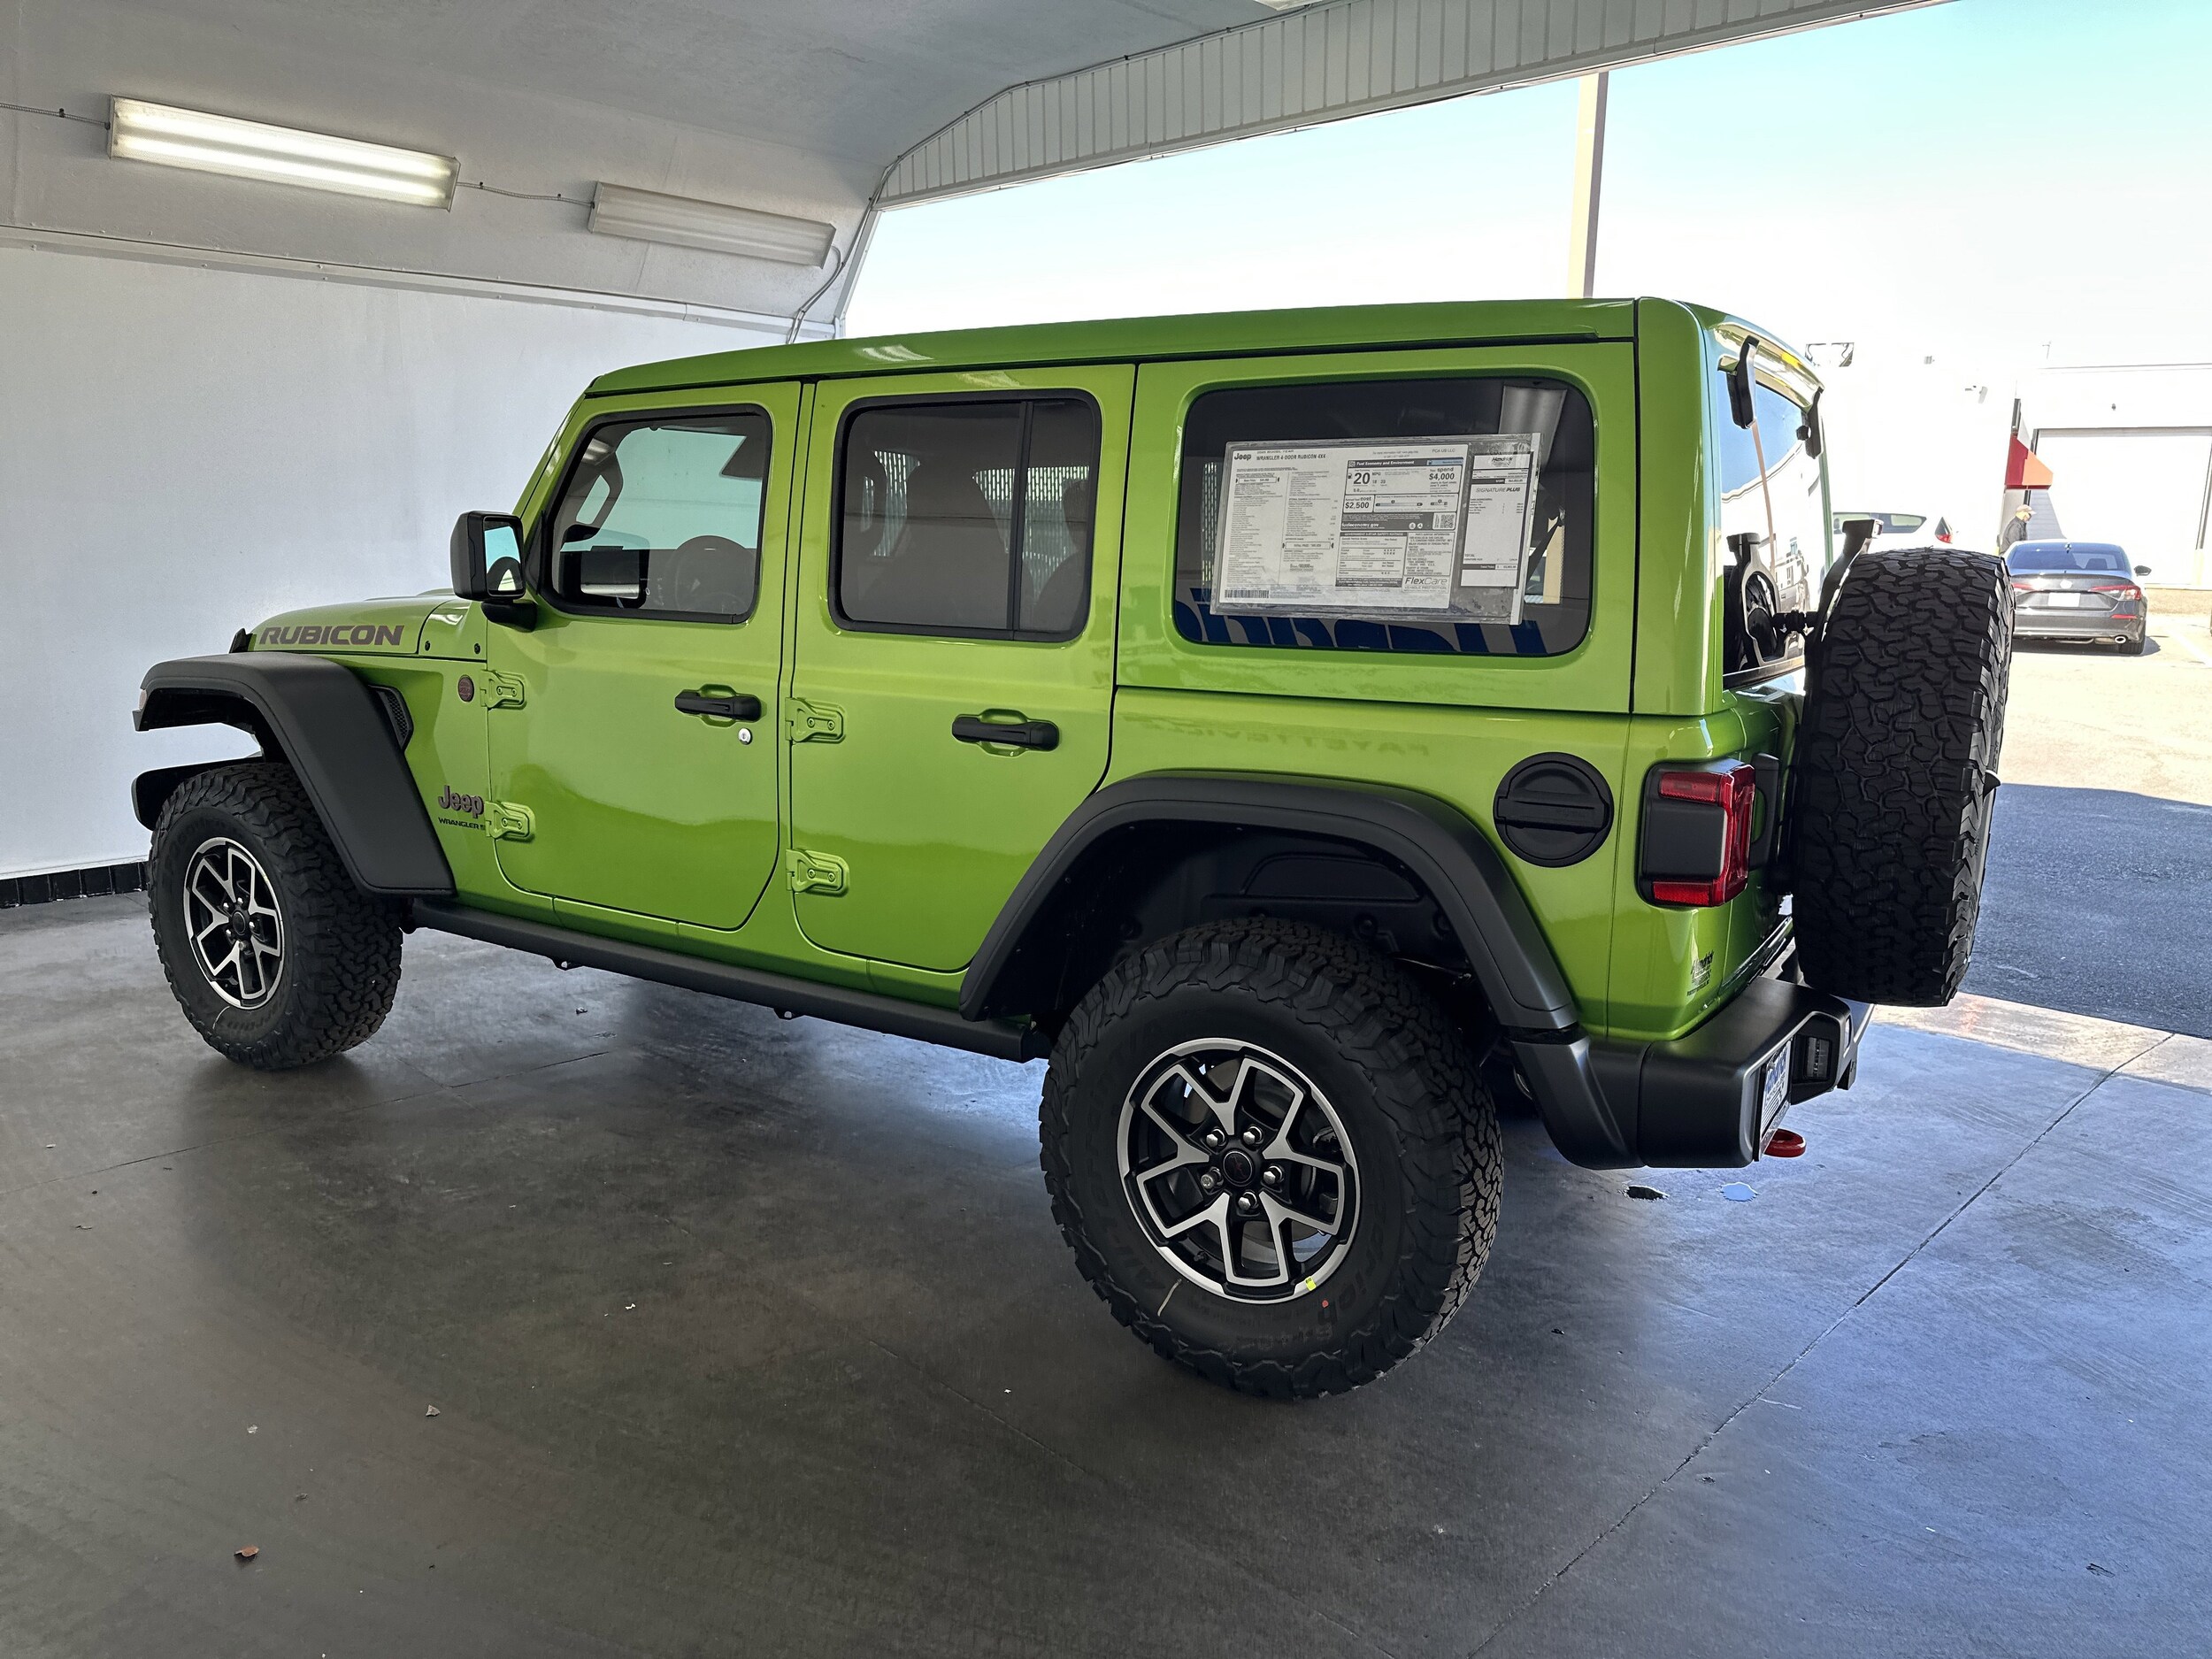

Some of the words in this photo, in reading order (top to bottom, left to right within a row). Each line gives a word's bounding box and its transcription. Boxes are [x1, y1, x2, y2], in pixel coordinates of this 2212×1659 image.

[1353, 472, 1370, 484] 20
[259, 625, 405, 646] RUBICON
[438, 785, 484, 818] Jeep
[438, 817, 480, 830] WRANGLER
